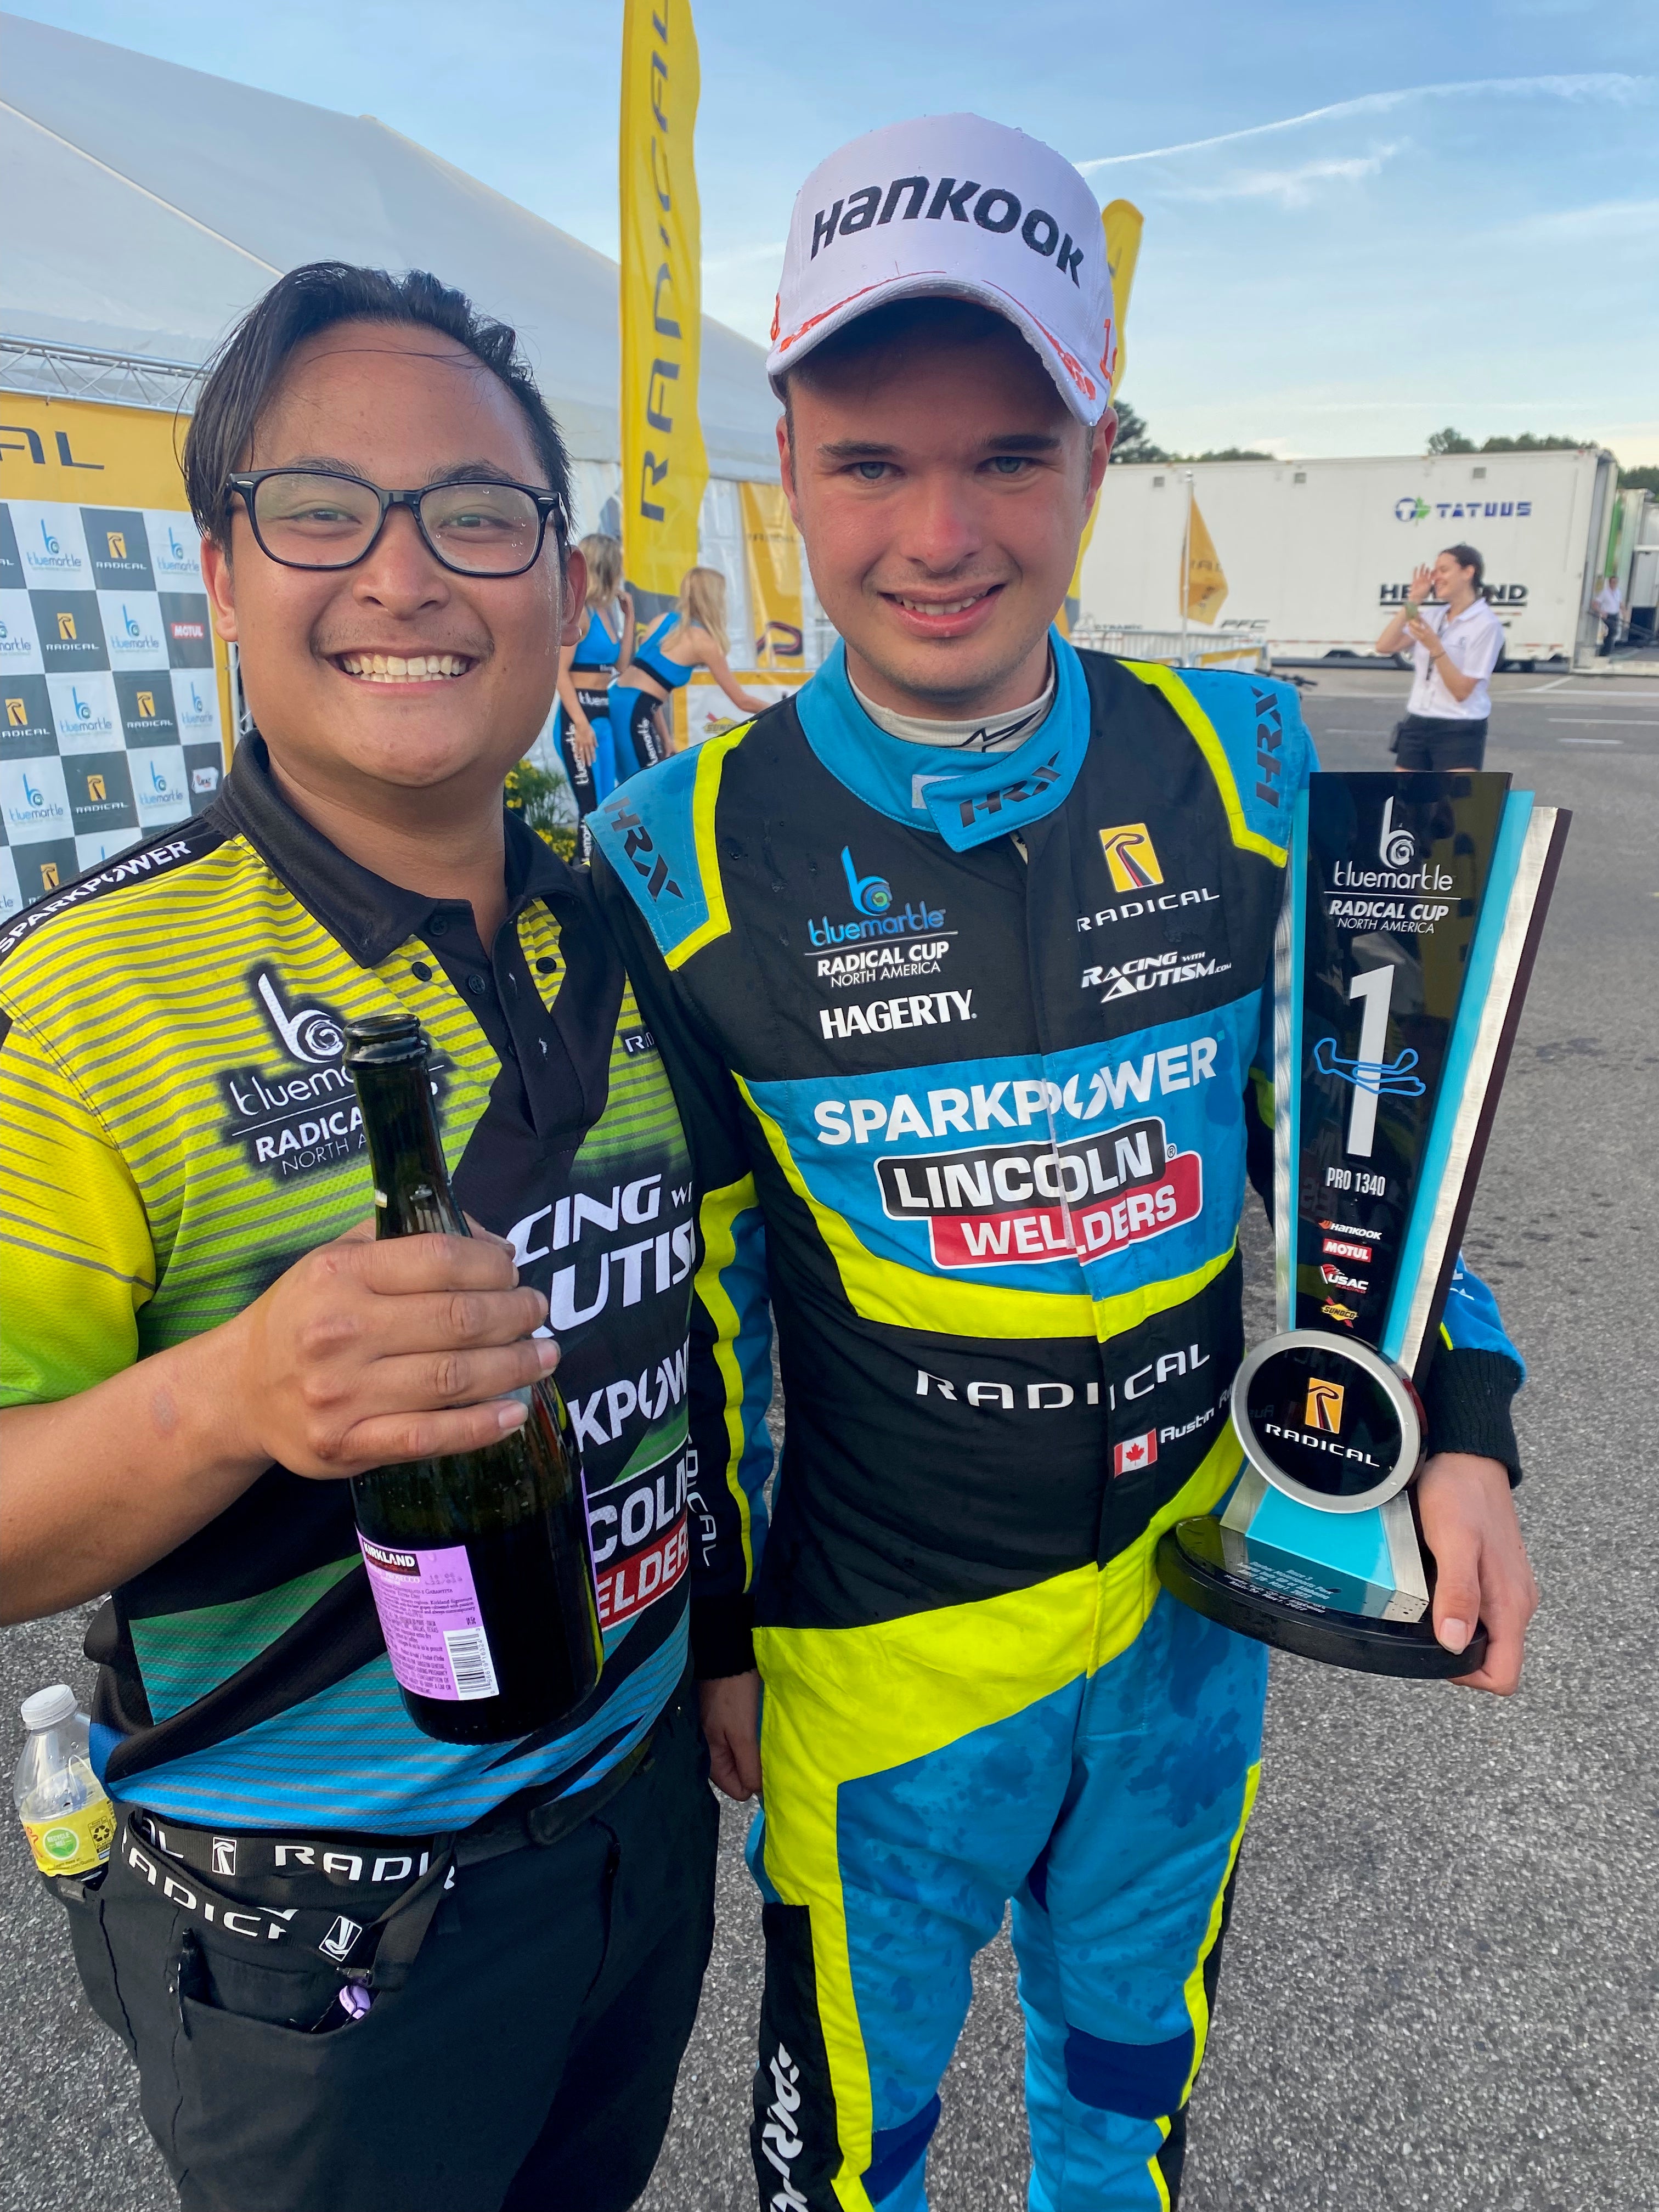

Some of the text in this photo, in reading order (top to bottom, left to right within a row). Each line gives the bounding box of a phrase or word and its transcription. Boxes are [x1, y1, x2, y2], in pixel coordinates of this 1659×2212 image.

[1436, 501, 1532, 518] TATUUS
[96, 561, 147, 570] RADICAL
[174, 624, 204, 637] MOTUL
[46, 644, 100, 652] RADICAL
[126, 719, 174, 729] RADICAL
[75, 802, 129, 814] RADICAL
[0, 840, 191, 953] SPARKPOWER
[1329, 898, 1449, 922] RADICAL CUP
[1078, 888, 1220, 933] RADICAL
[1337, 917, 1435, 934] NORTH AMERICA
[817, 941, 950, 977] RADICAL CUP
[1081, 951, 1205, 989] RACING WITH
[831, 961, 941, 988] NORTH AMERICA
[1346, 964, 1395, 1157] 1
[813, 1037, 1219, 1146] SPARKPOWER
[281, 1141, 350, 1175] NORTH
[893, 1130, 1154, 1209] LINCOLN
[1326, 1166, 1386, 1197] PRO 1340
[961, 1184, 1177, 1256] WELDERS
[1325, 1241, 1369, 1261] MOTUL
[1328, 1273, 1369, 1291] USAC
[1323, 1306, 1356, 1319] SUNOCO
[916, 1344, 1210, 1410] RADICAL
[1160, 1407, 1215, 1444] Austin
[1265, 1423, 1380, 1468] RADICAL
[363, 1541, 415, 1567] KIRKLAND
[47, 1832, 70, 1843] RECYCLE
